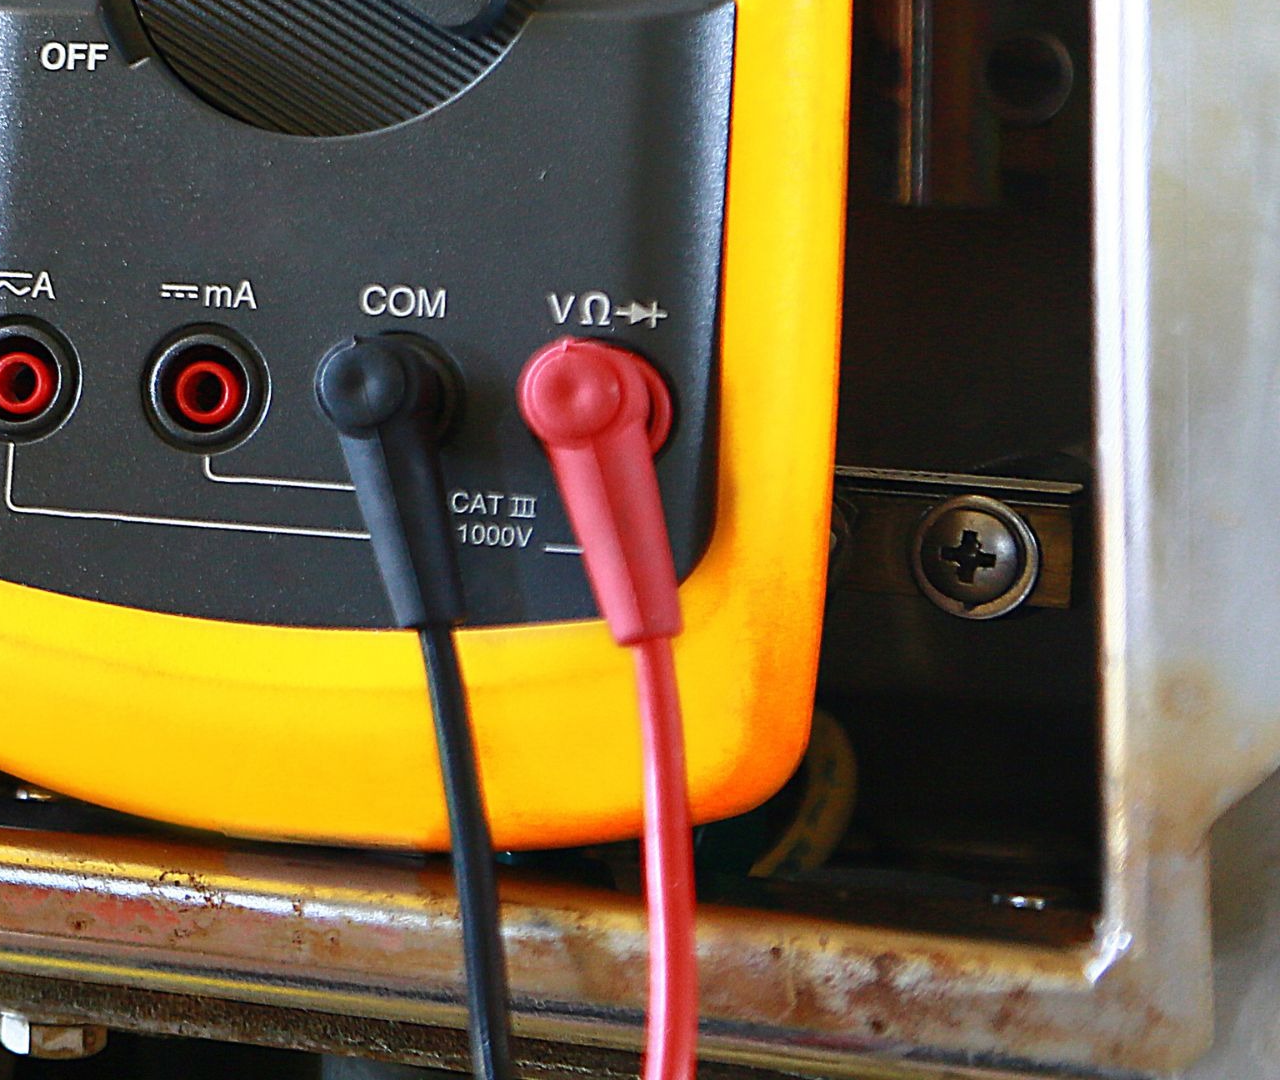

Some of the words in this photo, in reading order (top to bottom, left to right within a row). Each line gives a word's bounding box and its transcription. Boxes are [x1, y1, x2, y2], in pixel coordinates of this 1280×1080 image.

[41, 42, 109, 71] OFF
[31, 271, 56, 300] A
[205, 280, 257, 309] mA
[362, 285, 447, 318] COM
[451, 492, 504, 515] CAT
[509, 496, 536, 518] III
[458, 523, 533, 548] 1000V
